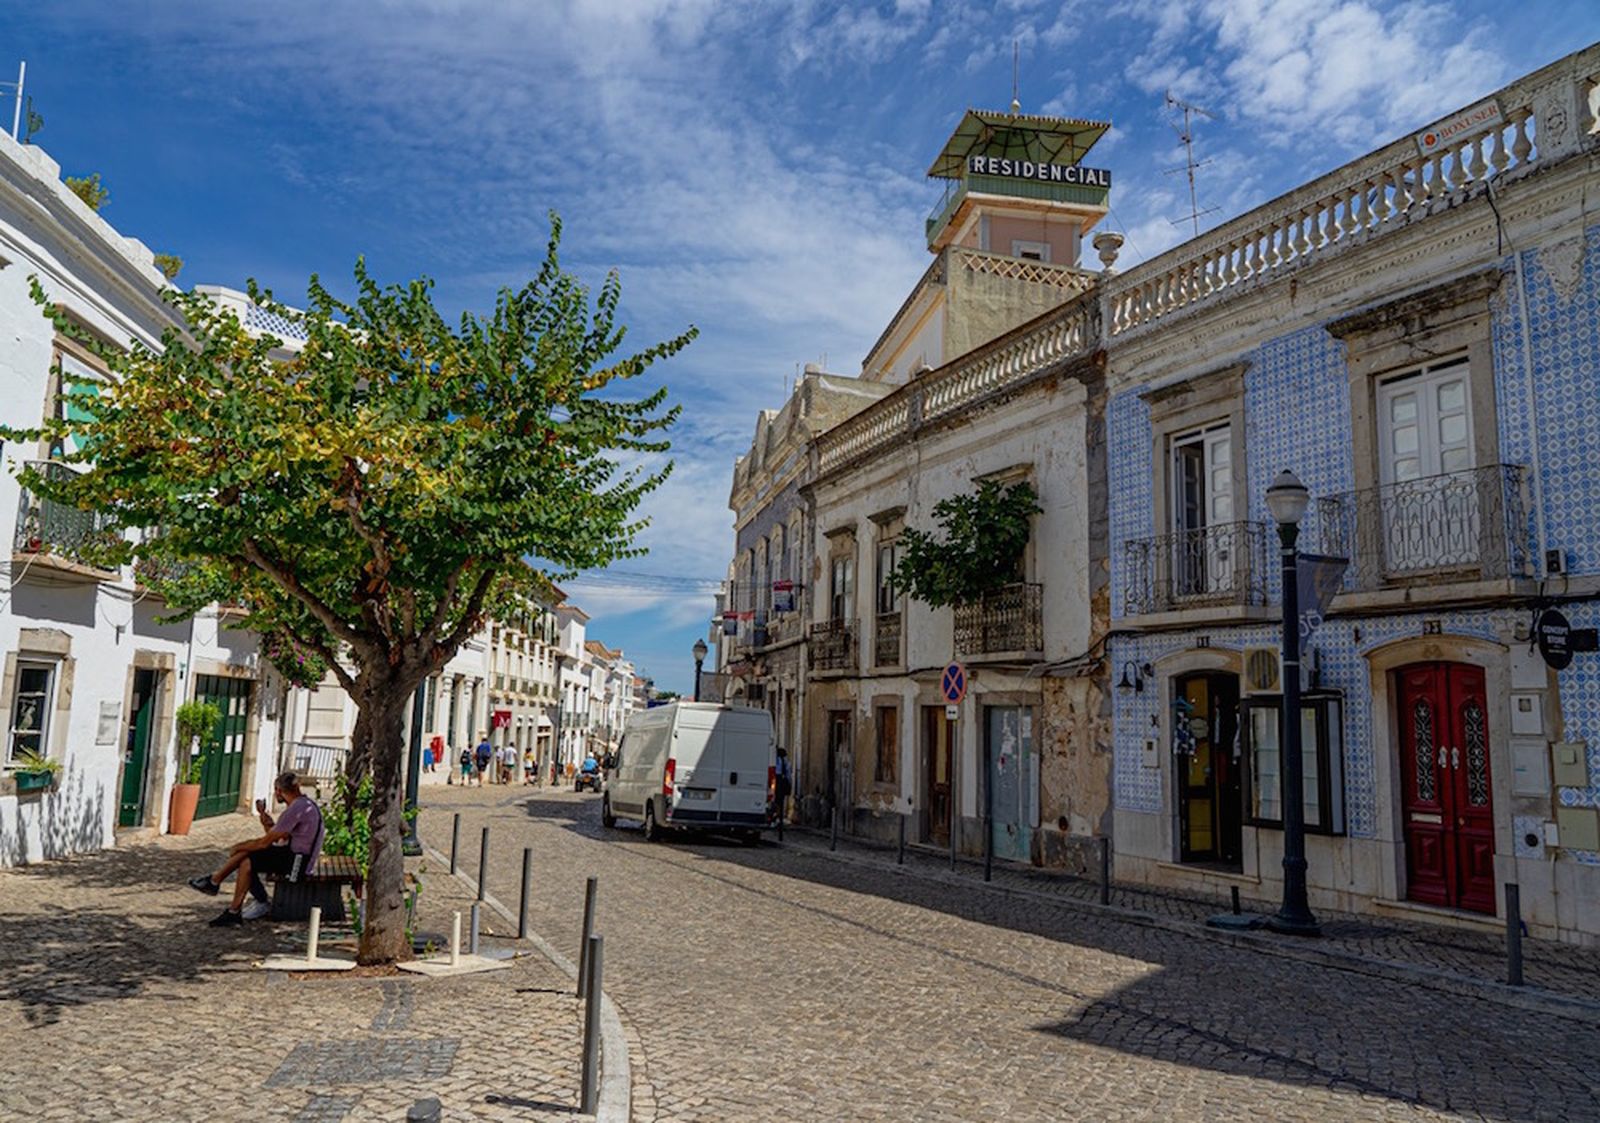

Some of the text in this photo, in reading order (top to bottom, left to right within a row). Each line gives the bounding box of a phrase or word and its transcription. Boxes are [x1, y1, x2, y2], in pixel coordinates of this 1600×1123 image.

[974, 156, 1108, 186] RESIDENCIAL
[1542, 624, 1569, 636] CONCEPT
[1546, 635, 1567, 645] STORE
